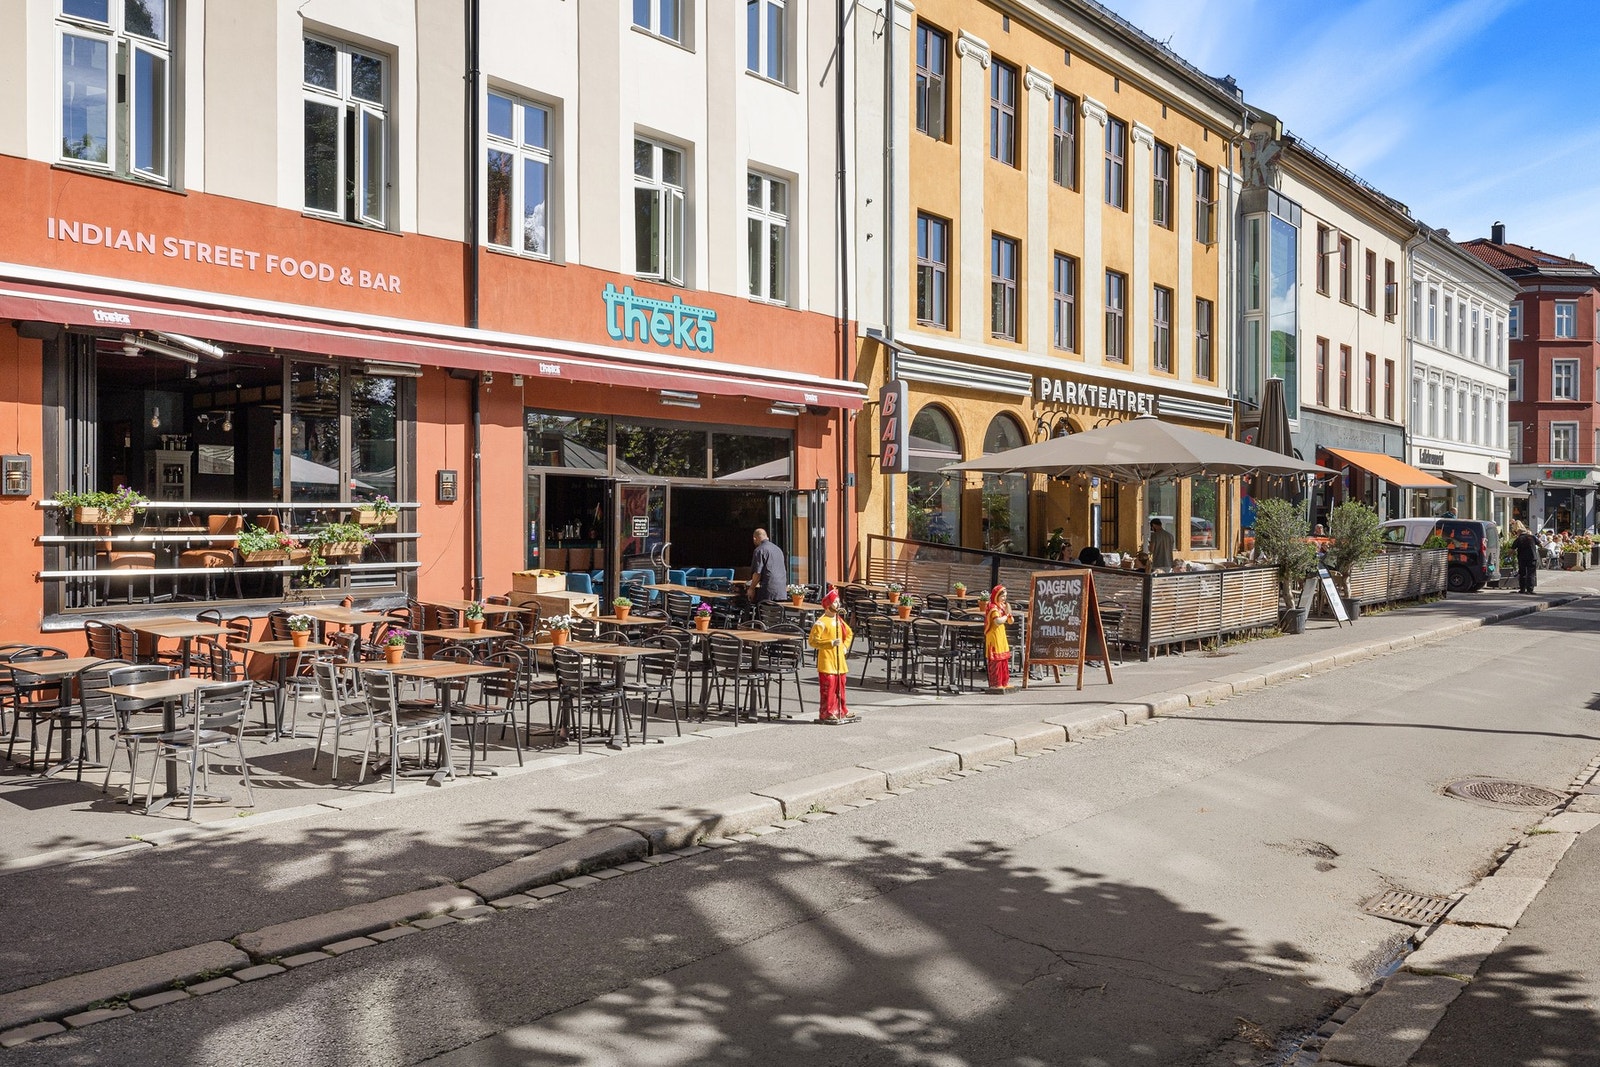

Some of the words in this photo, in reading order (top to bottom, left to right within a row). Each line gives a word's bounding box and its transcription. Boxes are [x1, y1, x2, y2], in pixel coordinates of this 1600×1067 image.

[47, 217, 156, 254] INDIAN
[163, 236, 260, 271] STREET
[266, 254, 334, 283] FOOD
[339, 266, 353, 287] &
[359, 270, 401, 294] BAR
[602, 282, 717, 353] theka
[1041, 377, 1155, 415] PARKTEATRET
[882, 392, 899, 467] BAR
[1037, 580, 1081, 597] DAGENS
[1040, 625, 1065, 637] THALI
